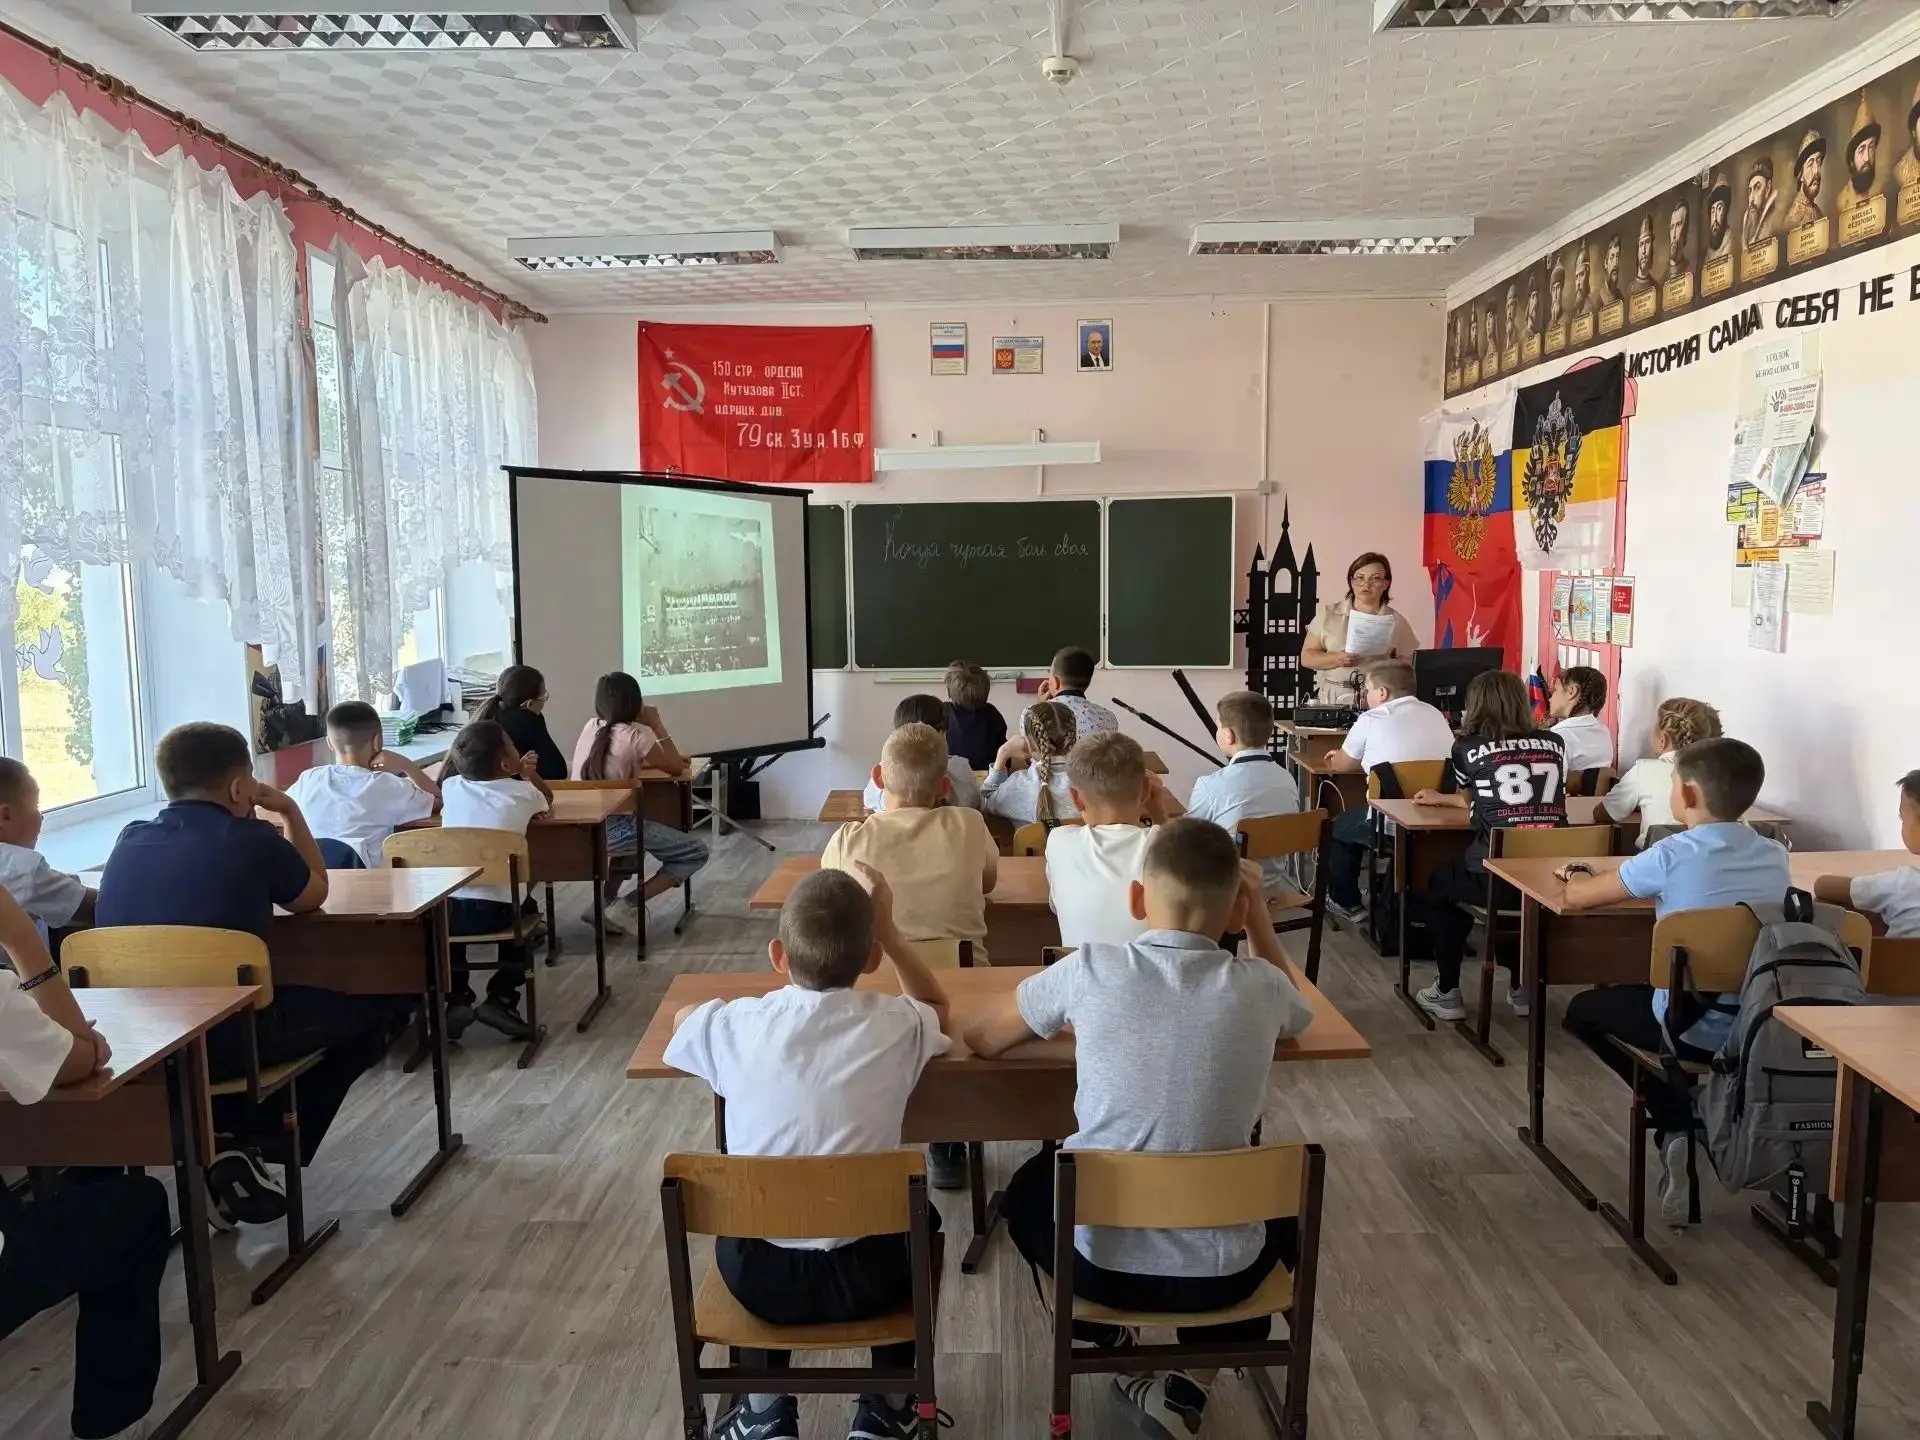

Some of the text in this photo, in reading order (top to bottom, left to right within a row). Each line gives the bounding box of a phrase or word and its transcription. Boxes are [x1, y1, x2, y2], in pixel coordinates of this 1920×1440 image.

[1628, 333, 1701, 378] ИСТОРИЯ
[1708, 303, 1762, 353] САМА
[1775, 288, 1841, 329] СЕБЯ
[1858, 273, 1894, 315] НЕ
[712, 360, 731, 376] 150
[764, 365, 803, 379] ОРДЕНА
[736, 422, 762, 447] 79
[1016, 536, 1047, 558] боль
[1054, 532, 1089, 556] своя
[1494, 762, 1560, 806] 87
[1497, 805, 1535, 816] COLLEGE
[1795, 1121, 1833, 1130] FASHION
